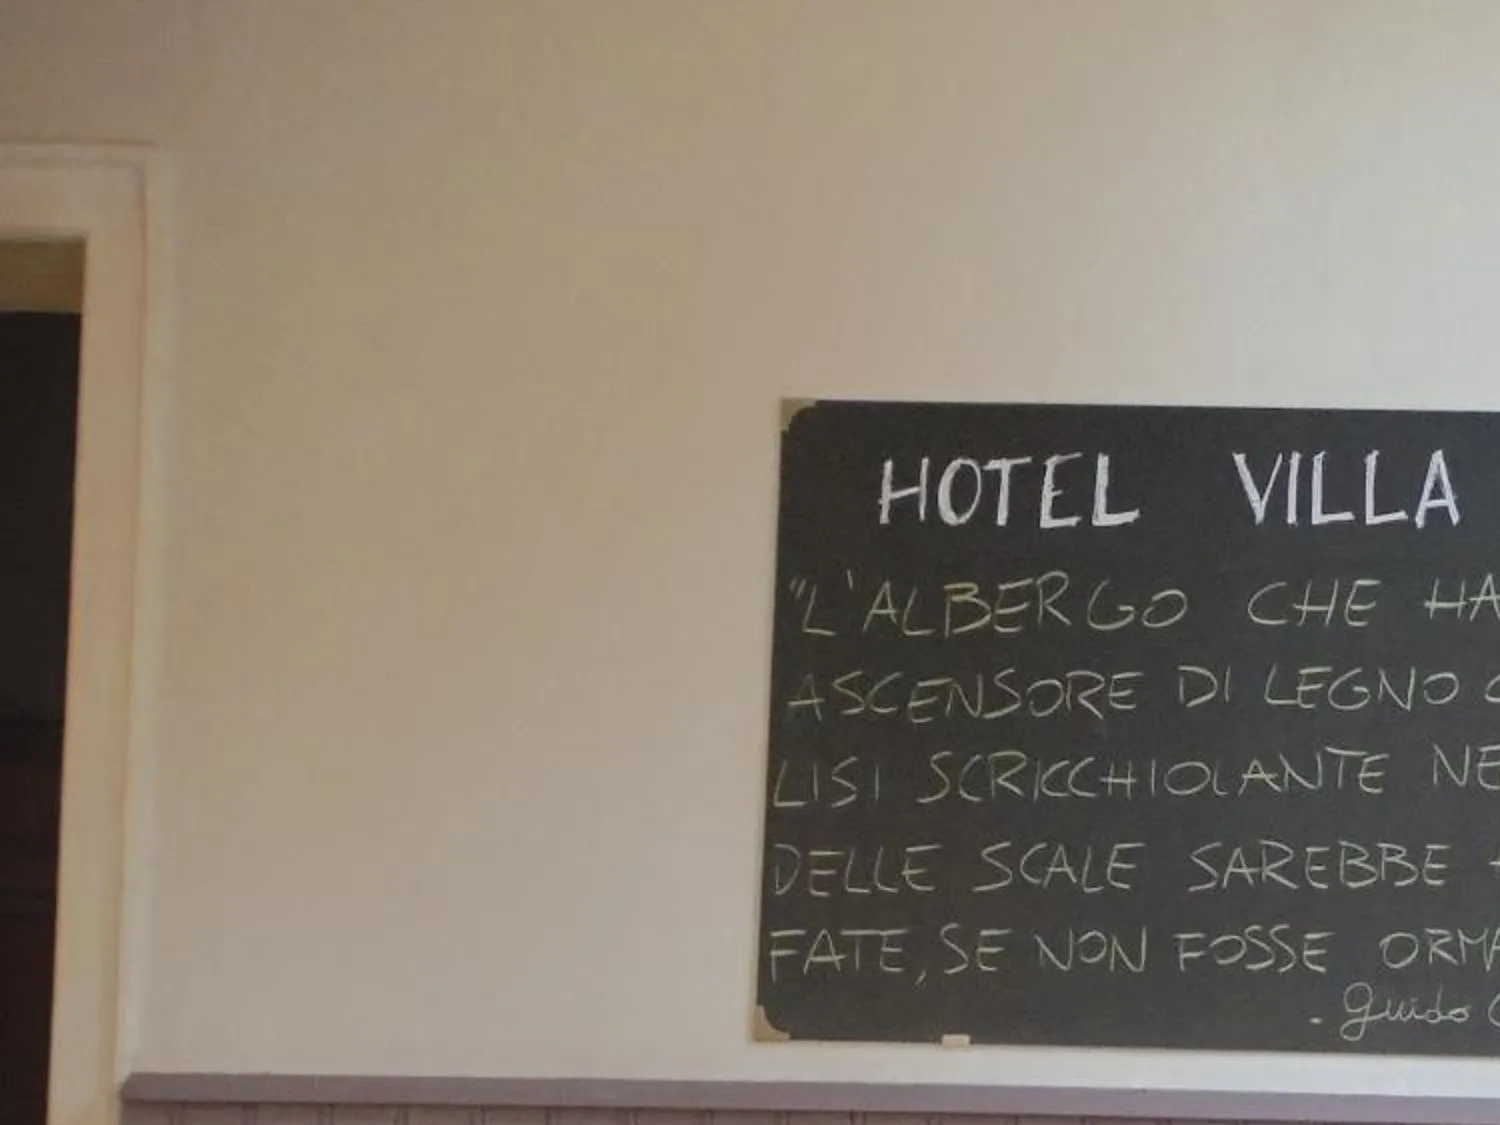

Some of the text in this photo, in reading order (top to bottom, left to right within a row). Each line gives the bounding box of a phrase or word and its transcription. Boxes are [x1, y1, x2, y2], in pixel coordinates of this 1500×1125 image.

[878, 450, 1141, 529] HOTEL
[1232, 448, 1461, 528] VILLA
[1246, 578, 1381, 629] CHE
[788, 667, 1144, 723] ASCENSORE
[1177, 665, 1232, 709] DI
[1264, 664, 1460, 711] LEGNO
[772, 757, 881, 808] LISI
[916, 748, 1391, 802] SCRICCHIOLANTE
[772, 843, 943, 897] DELLE
[972, 840, 1146, 893] SCALE
[1188, 838, 1450, 892] SAREBBE
[943, 923, 1013, 974] SE
[1034, 926, 1147, 974] NON
[1173, 923, 1335, 976] FOSSE
